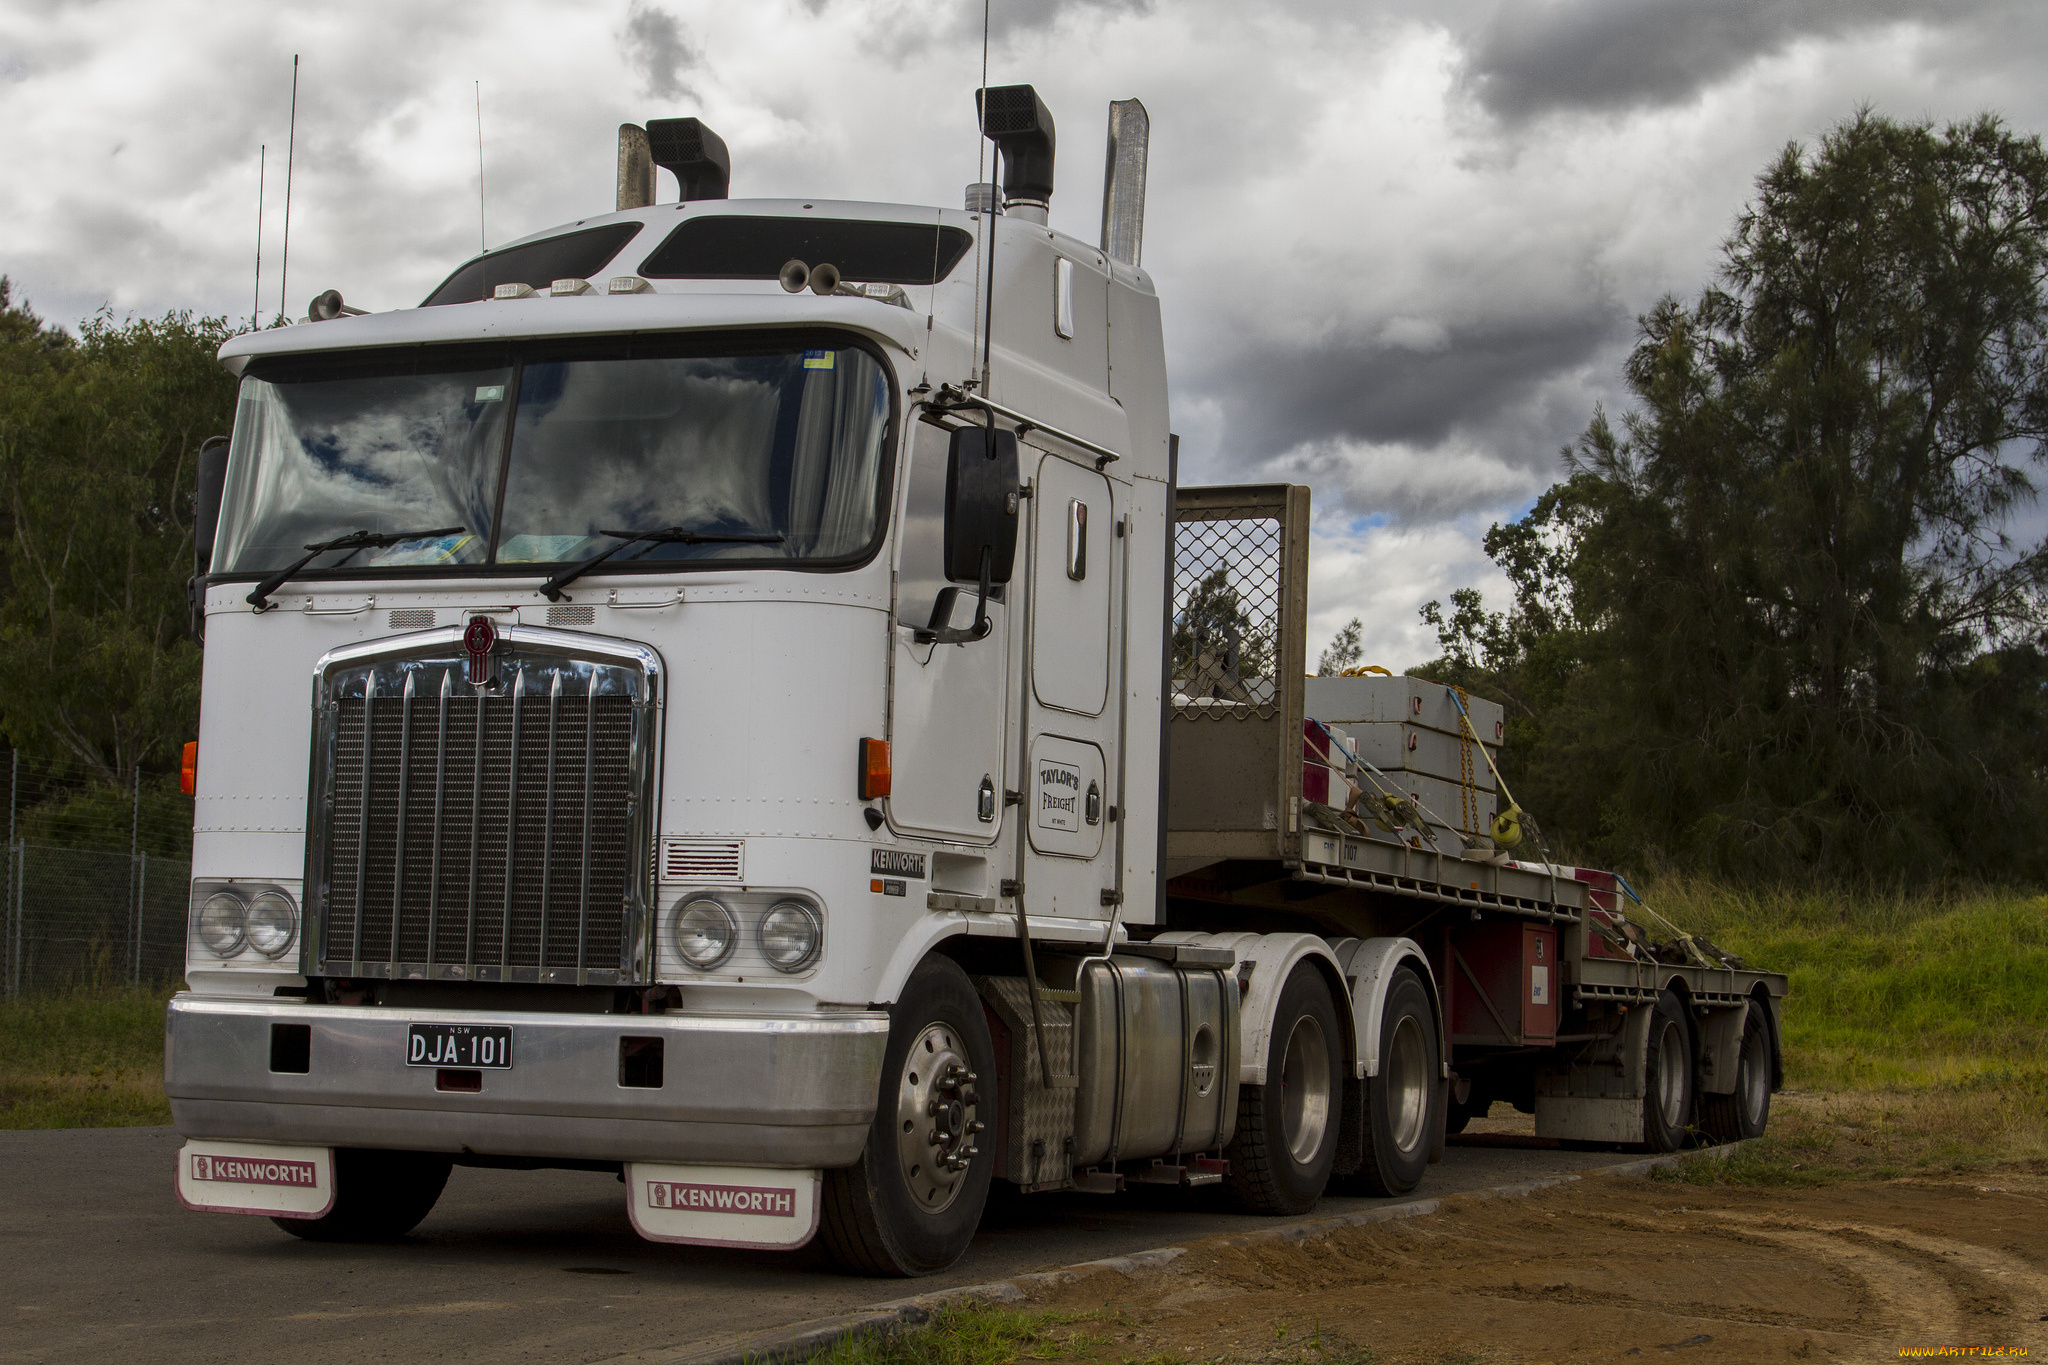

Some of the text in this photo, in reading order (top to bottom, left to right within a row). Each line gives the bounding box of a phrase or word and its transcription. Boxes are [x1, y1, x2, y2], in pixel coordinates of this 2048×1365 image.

[471, 638, 485, 649] W
[474, 627, 482, 638] K
[1041, 769, 1079, 791] TAYLOR'S
[1043, 791, 1075, 814] FREIGHT
[873, 850, 925, 873] KENWORTH
[215, 1161, 313, 1183] KENWORTH
[675, 1188, 791, 1212] KENWORTH
